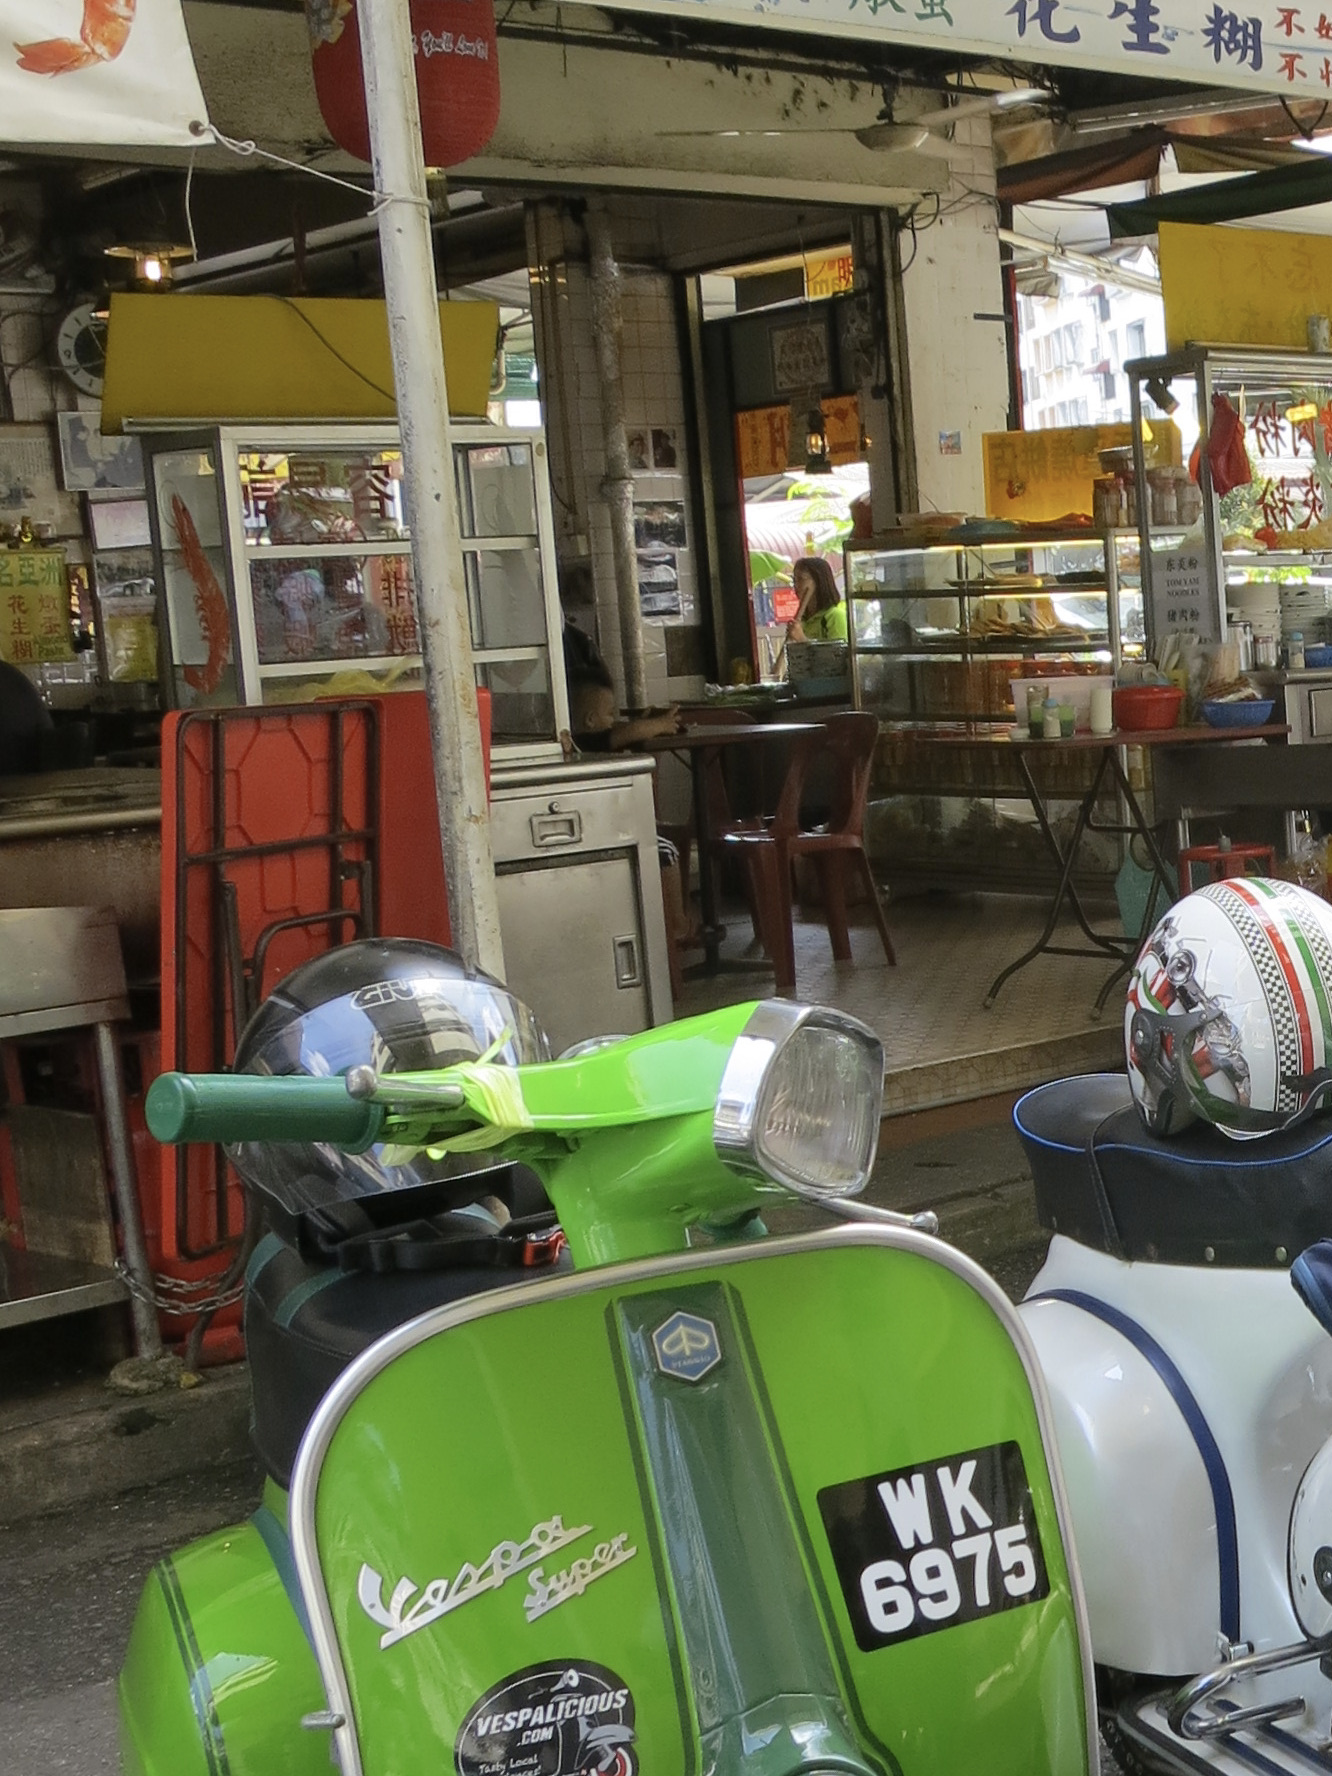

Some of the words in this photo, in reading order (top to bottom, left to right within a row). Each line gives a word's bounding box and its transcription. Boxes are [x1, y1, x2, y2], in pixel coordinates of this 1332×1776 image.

[877, 1459, 993, 1550] WK
[357, 1515, 594, 1651] Vespa
[523, 1532, 637, 1623] Super
[860, 1523, 1037, 1634] 6975
[476, 1688, 629, 1737] VESPALICIOUS
[516, 1725, 555, 1747] .COM
[509, 1753, 539, 1767] Local
